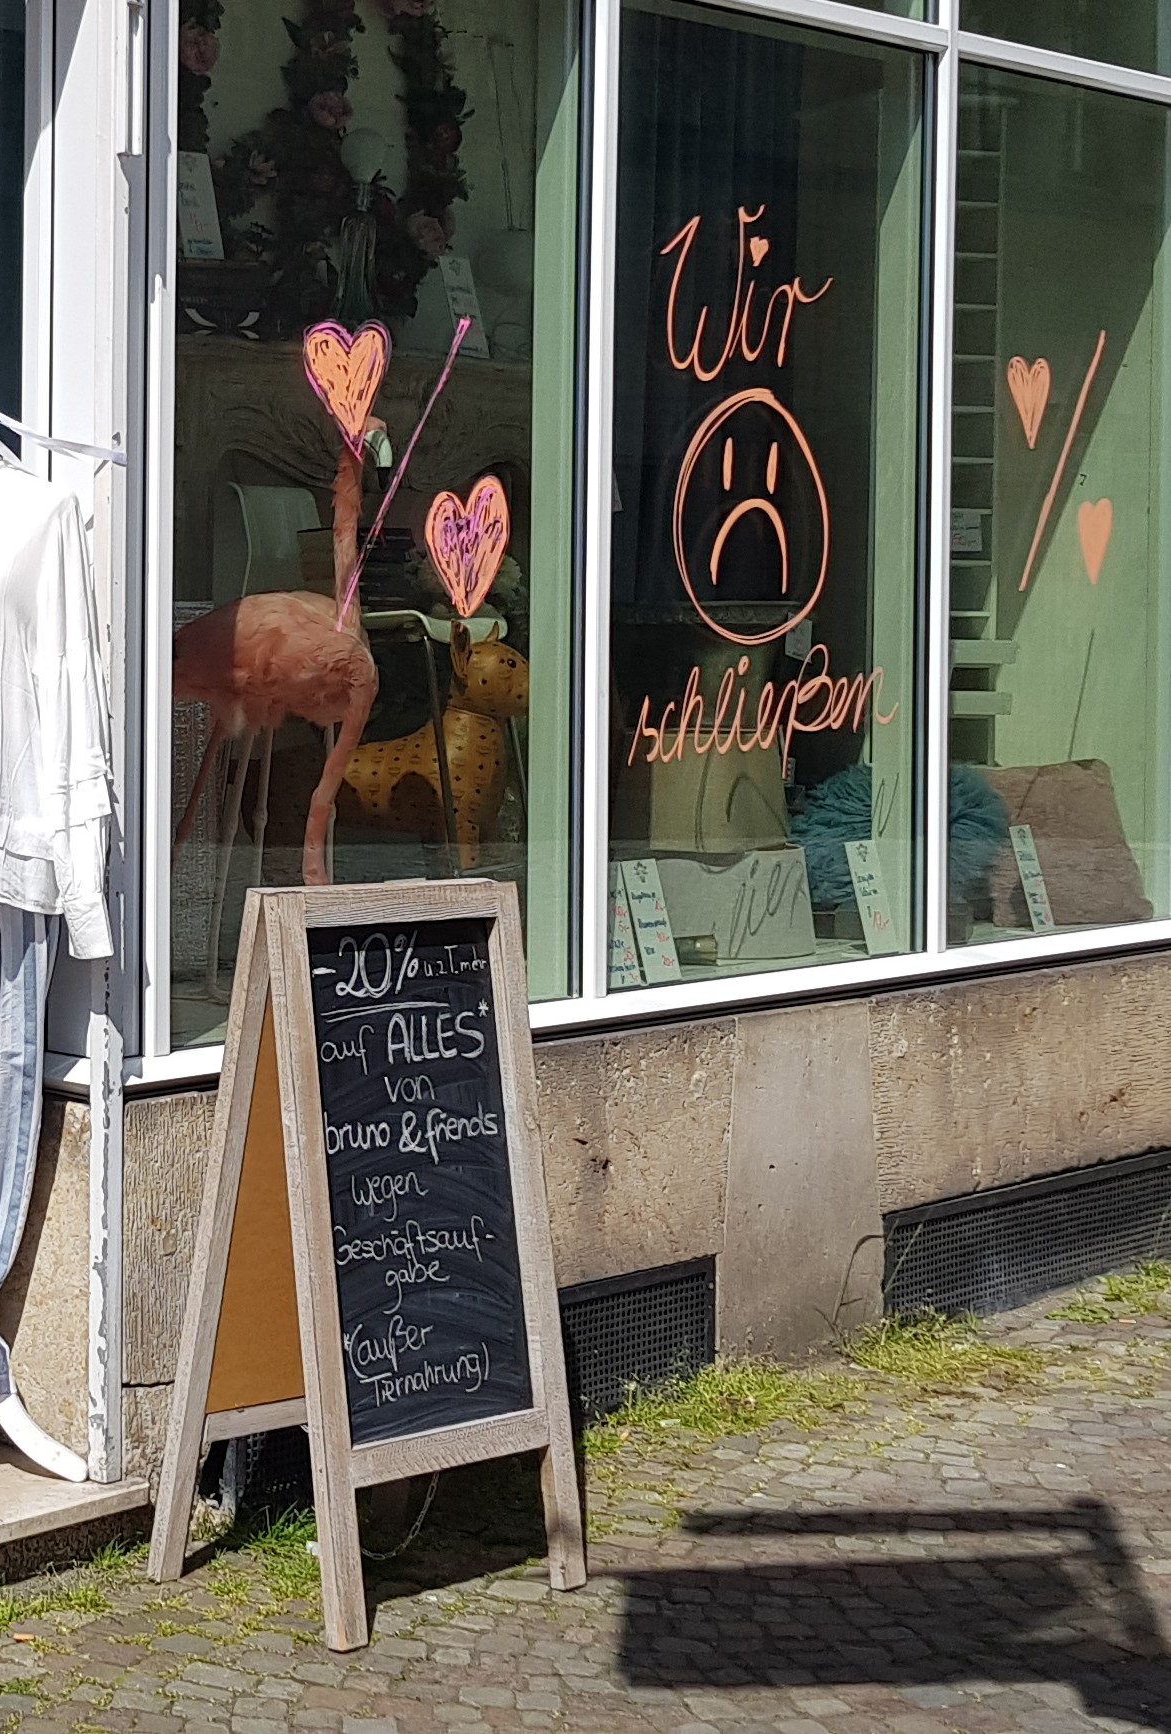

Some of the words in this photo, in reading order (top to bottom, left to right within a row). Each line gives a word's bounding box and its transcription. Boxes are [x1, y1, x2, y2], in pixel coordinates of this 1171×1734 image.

[660, 203, 833, 381] Wir
[628, 643, 899, 780] schließen
[312, 929, 420, 998] -20%
[320, 1024, 375, 1076] auf
[383, 1074, 435, 1103] von
[323, 1106, 391, 1155] bruno
[398, 1110, 429, 1153] &
[424, 1101, 499, 1166] friends
[351, 1171, 429, 1223] wegen
[382, 1259, 451, 1315] gabe
